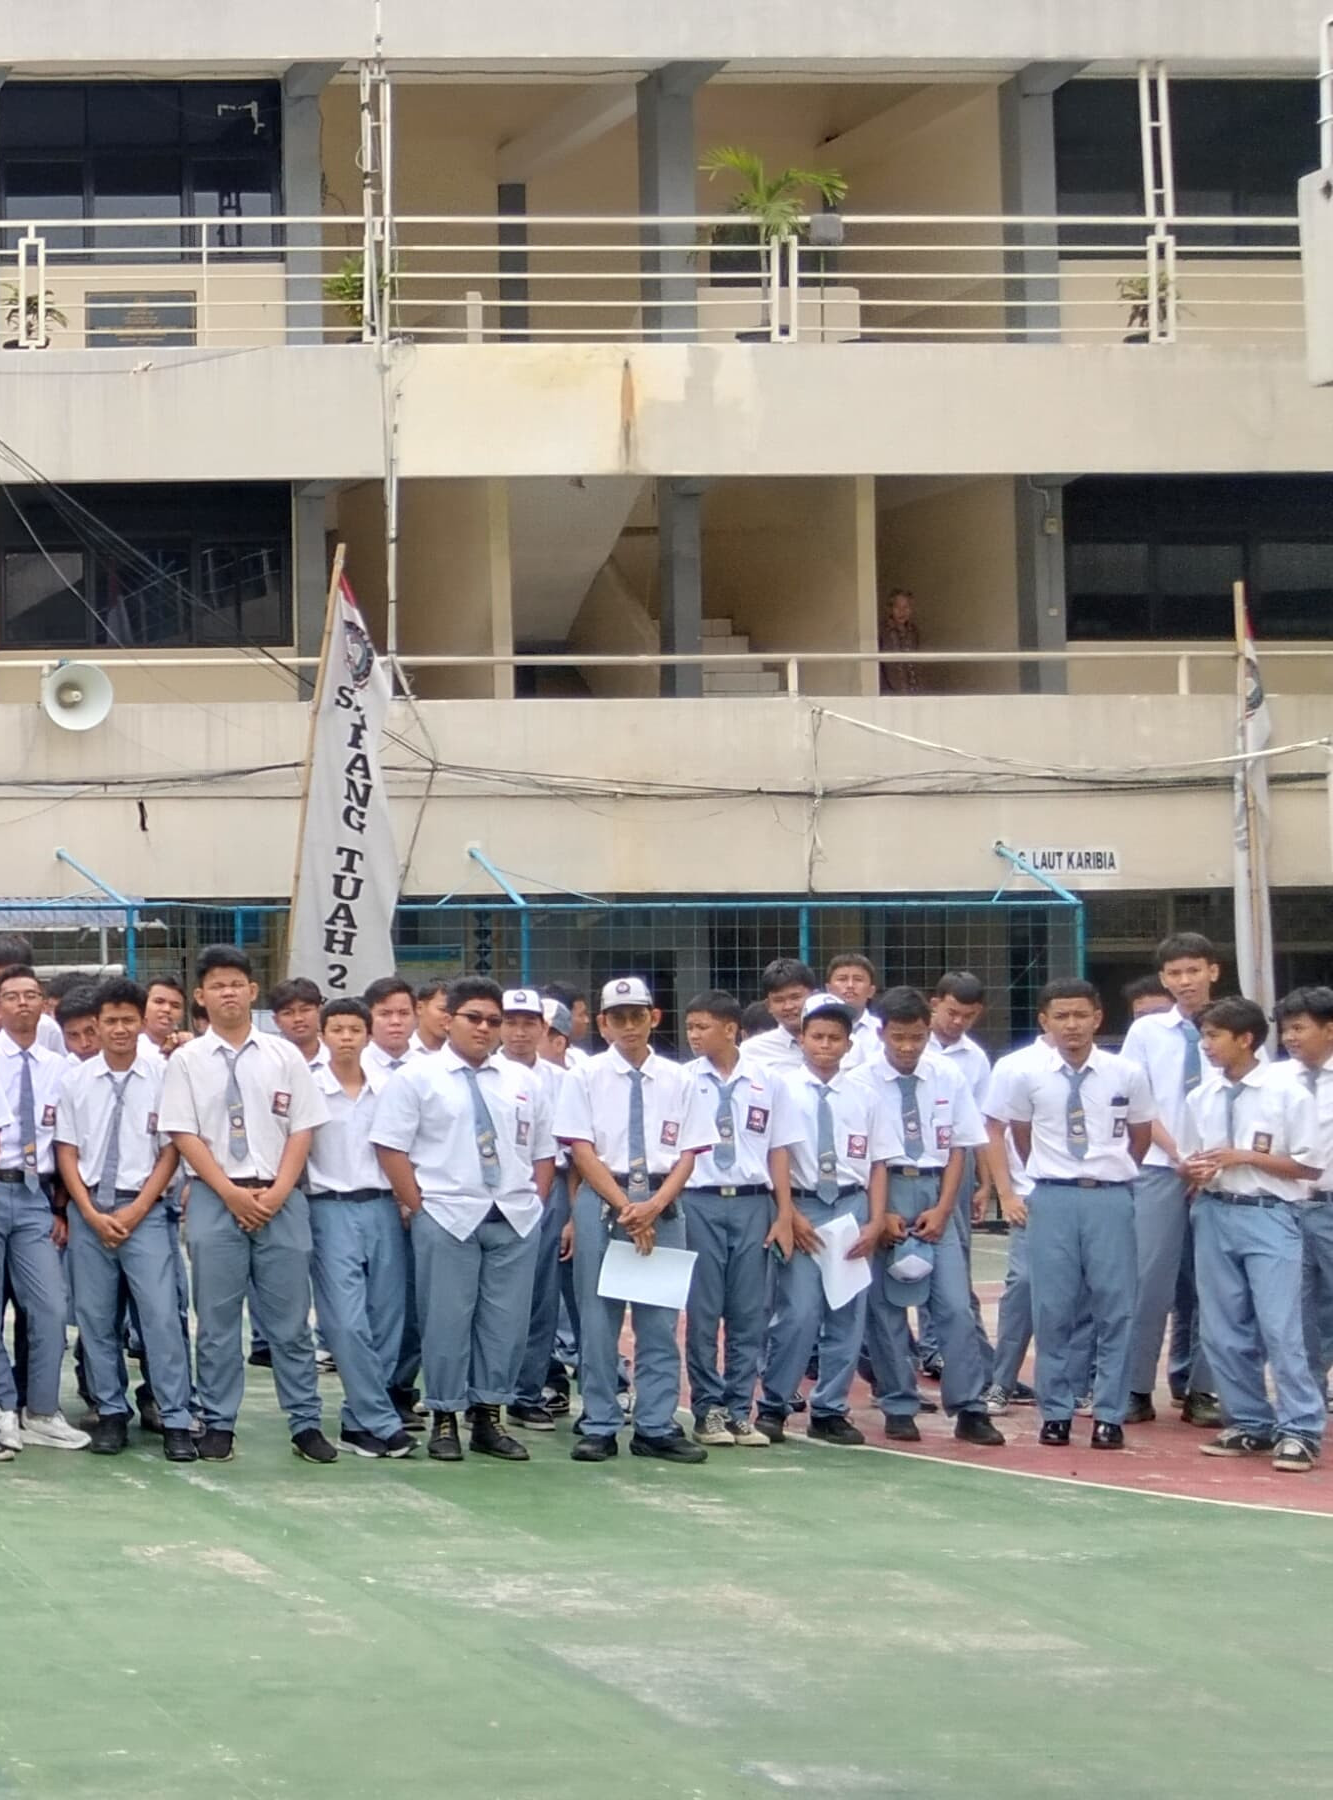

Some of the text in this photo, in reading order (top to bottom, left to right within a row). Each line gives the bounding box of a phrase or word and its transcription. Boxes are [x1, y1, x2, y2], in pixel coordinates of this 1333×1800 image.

[1032, 851, 1064, 870] LAUT
[1066, 851, 1117, 870] KARIBIA
[323, 846, 364, 957] TUAH
[326, 963, 347, 991] 2
